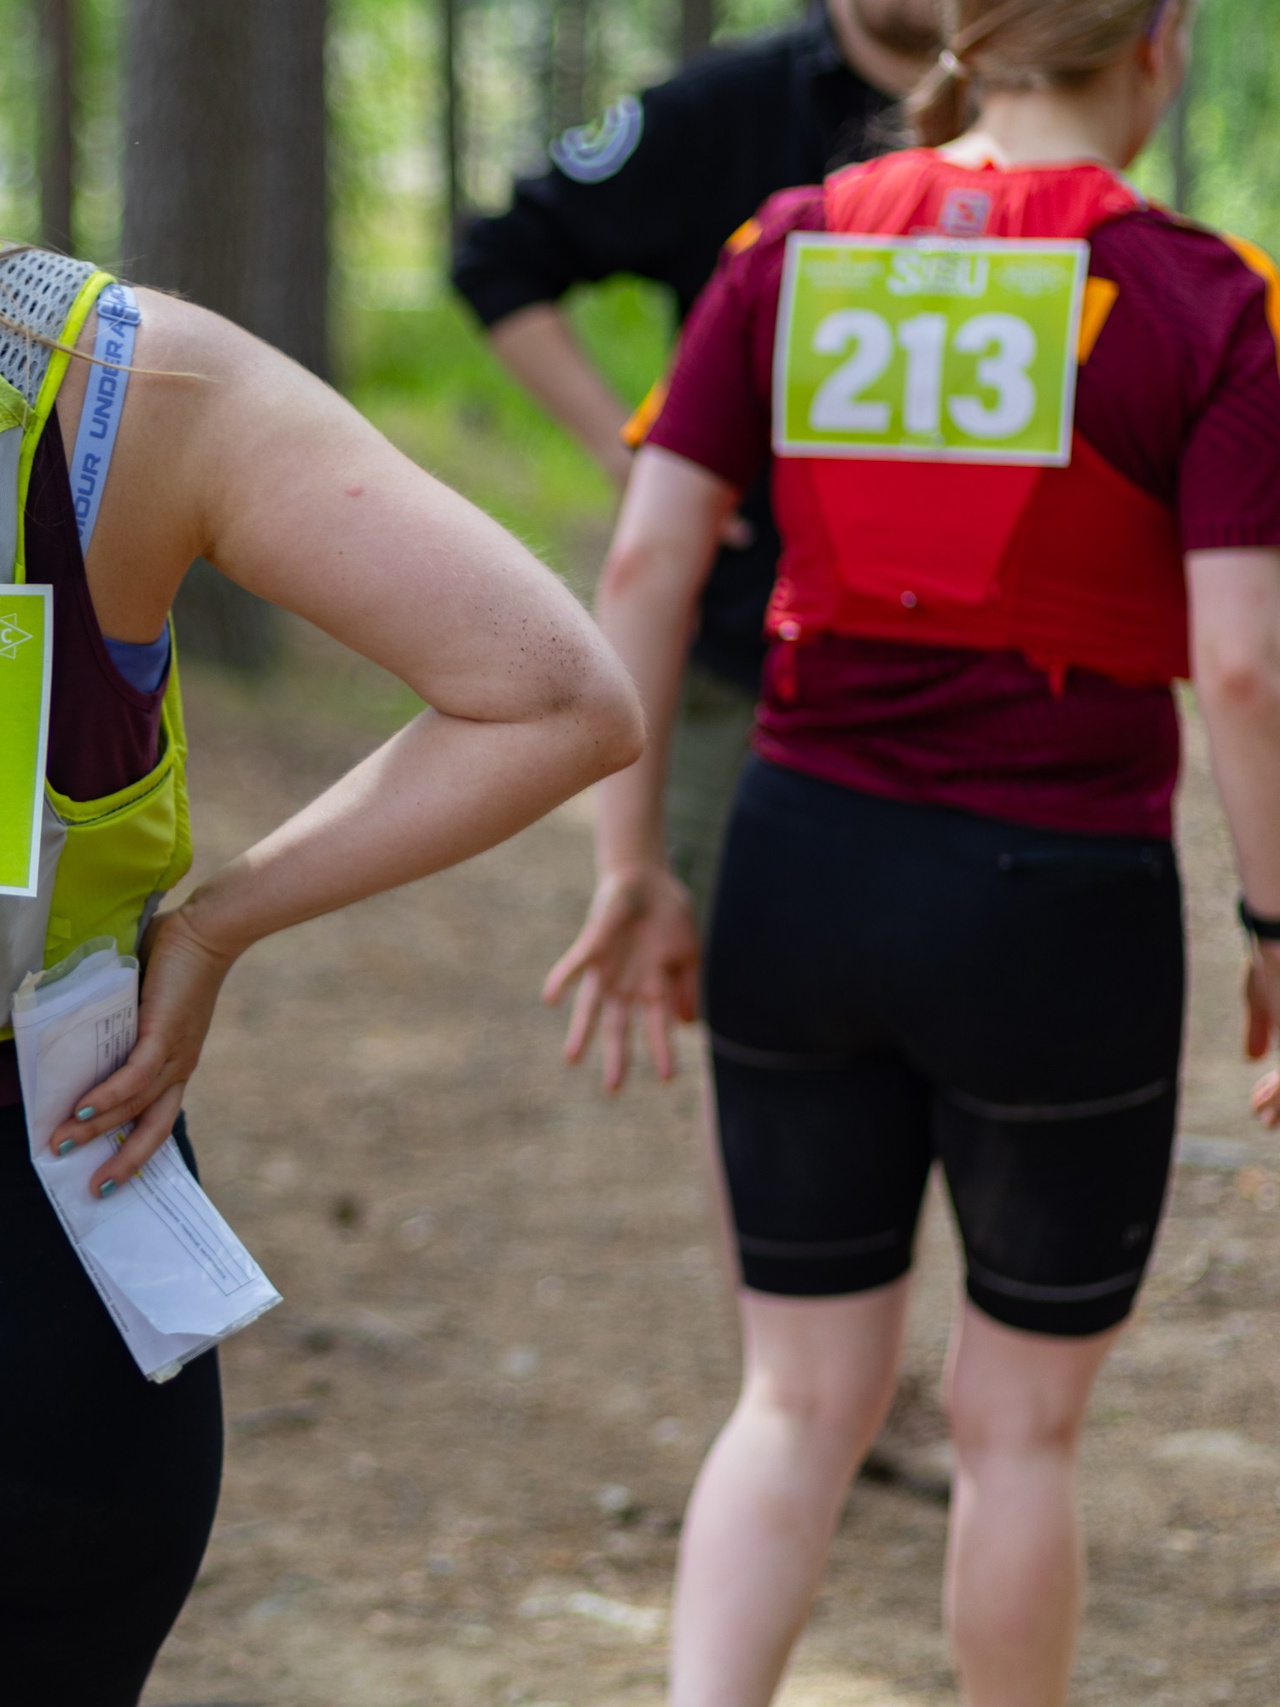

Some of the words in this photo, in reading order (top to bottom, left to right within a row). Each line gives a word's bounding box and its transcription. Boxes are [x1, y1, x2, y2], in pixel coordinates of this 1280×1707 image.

[74, 452, 101, 537] OUR
[89, 342, 124, 440] UNDER
[808, 308, 1037, 439] 213
